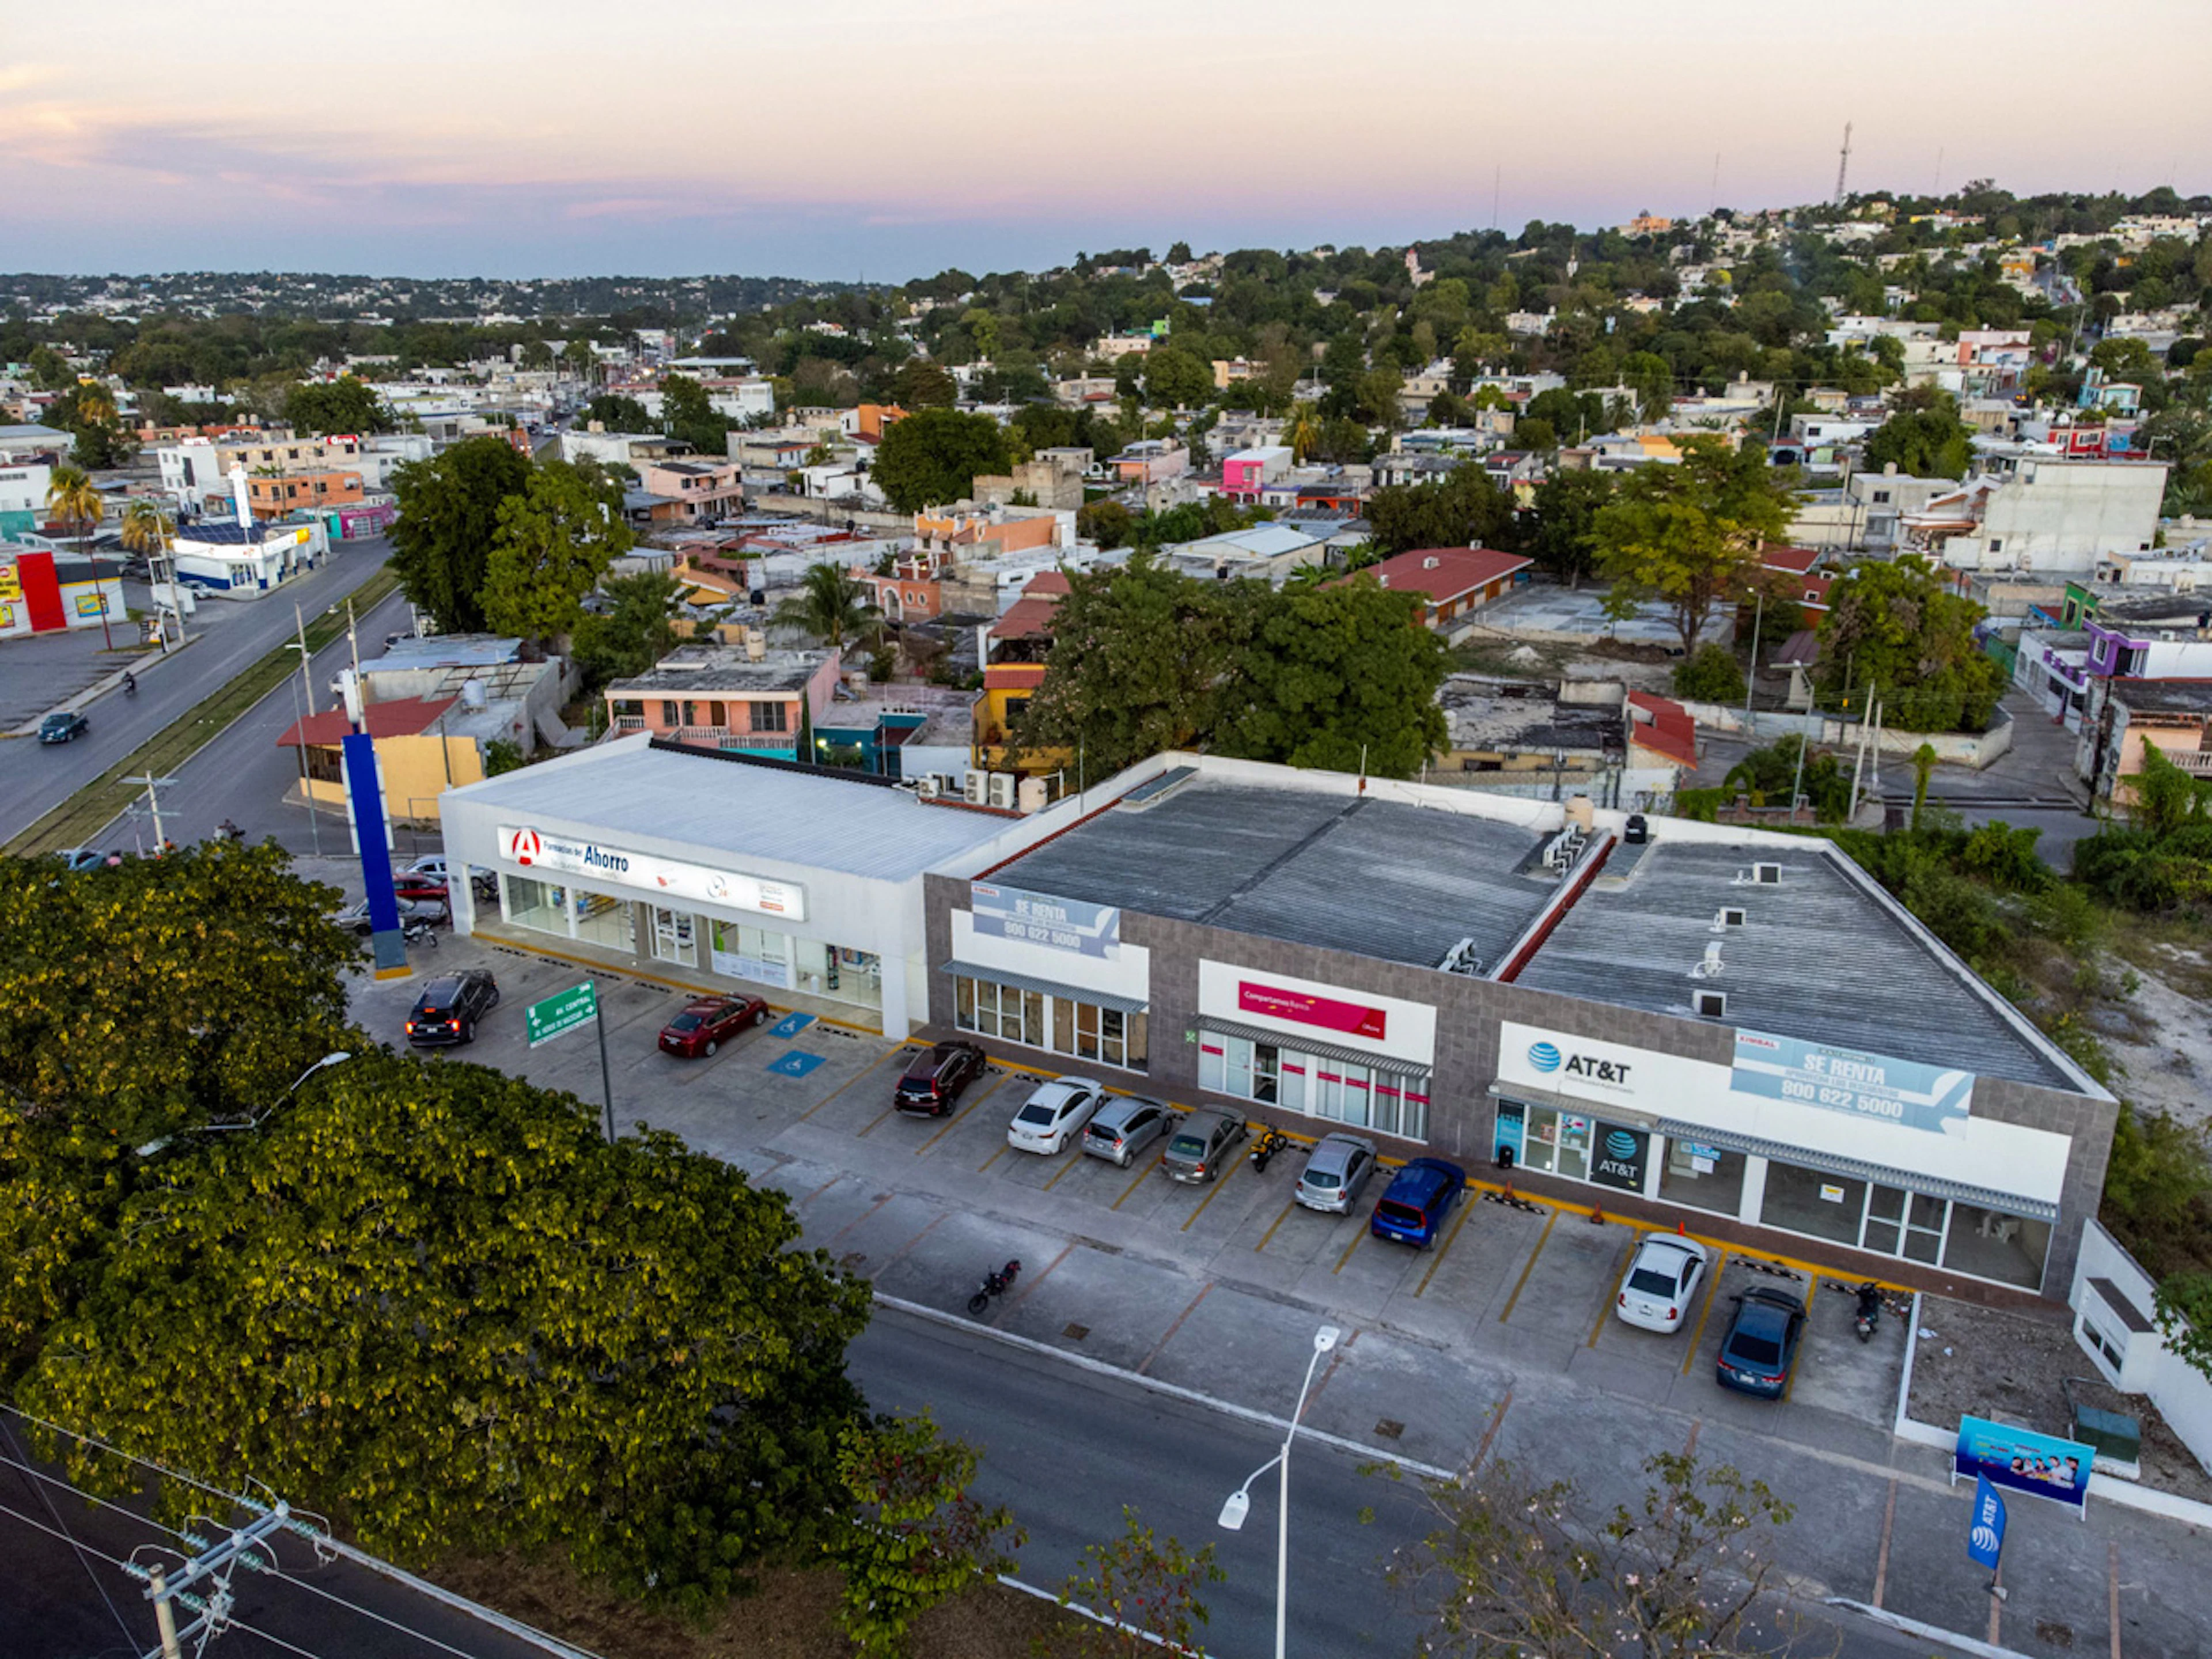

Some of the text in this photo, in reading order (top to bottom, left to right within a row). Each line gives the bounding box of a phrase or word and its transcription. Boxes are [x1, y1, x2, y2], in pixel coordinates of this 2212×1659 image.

[584, 846, 628, 872] Ahorro
[1015, 899, 1029, 916] SE
[1032, 903, 1066, 922] RENTA
[1052, 931, 1081, 948] 5000
[1565, 1054, 1631, 1084] AT&T
[1804, 1054, 1827, 1073] SE
[1830, 1059, 1885, 1085] RENTA
[1782, 1079, 1815, 1100] 800
[1819, 1087, 1852, 1108] 622
[1857, 1096, 1903, 1118] 5000
[1599, 1159, 1638, 1178] AT&T
[1982, 1494, 1998, 1527] AT&T
